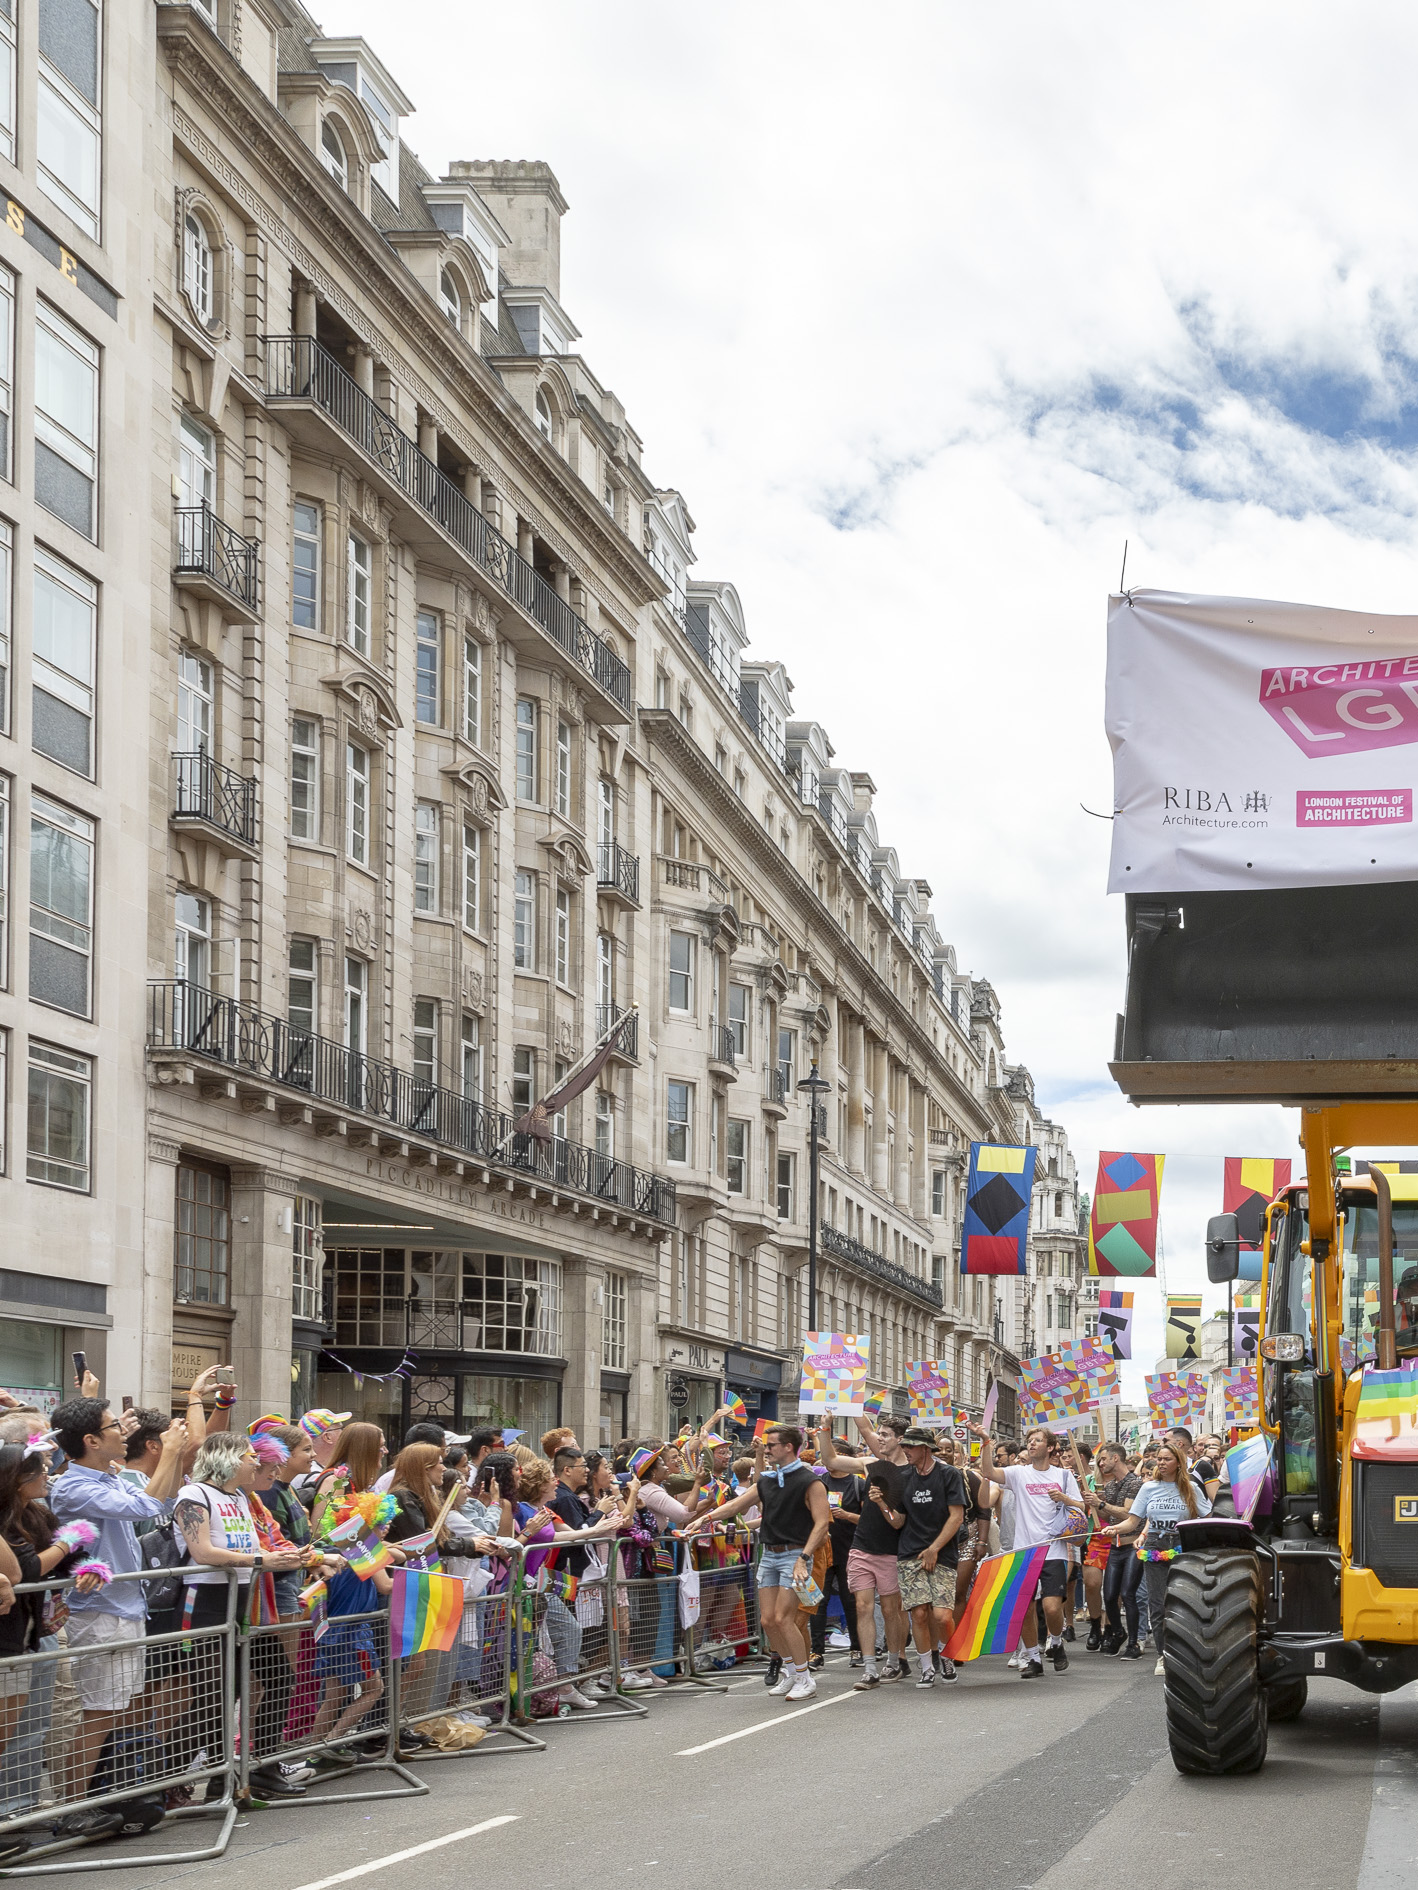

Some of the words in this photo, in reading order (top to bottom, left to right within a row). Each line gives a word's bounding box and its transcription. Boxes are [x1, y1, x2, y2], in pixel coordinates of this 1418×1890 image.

[1163, 786, 1234, 813] RIBA
[1305, 797, 1343, 807] LONDON
[1345, 796, 1389, 806] FESTIVAL
[1391, 795, 1404, 804] OF
[1305, 806, 1404, 821] ARCHITECTURE
[1162, 814, 1268, 829] Architecture.com
[366, 1158, 475, 1203] PICCADILLY
[491, 1200, 545, 1227] ARCADE
[172, 1353, 201, 1365] MPIRE
[688, 1344, 711, 1369] PAUL
[811, 1358, 859, 1368] LGBT+
[1034, 1375, 1069, 1393] LGBT+
[226, 1533, 252, 1548] LIVE
